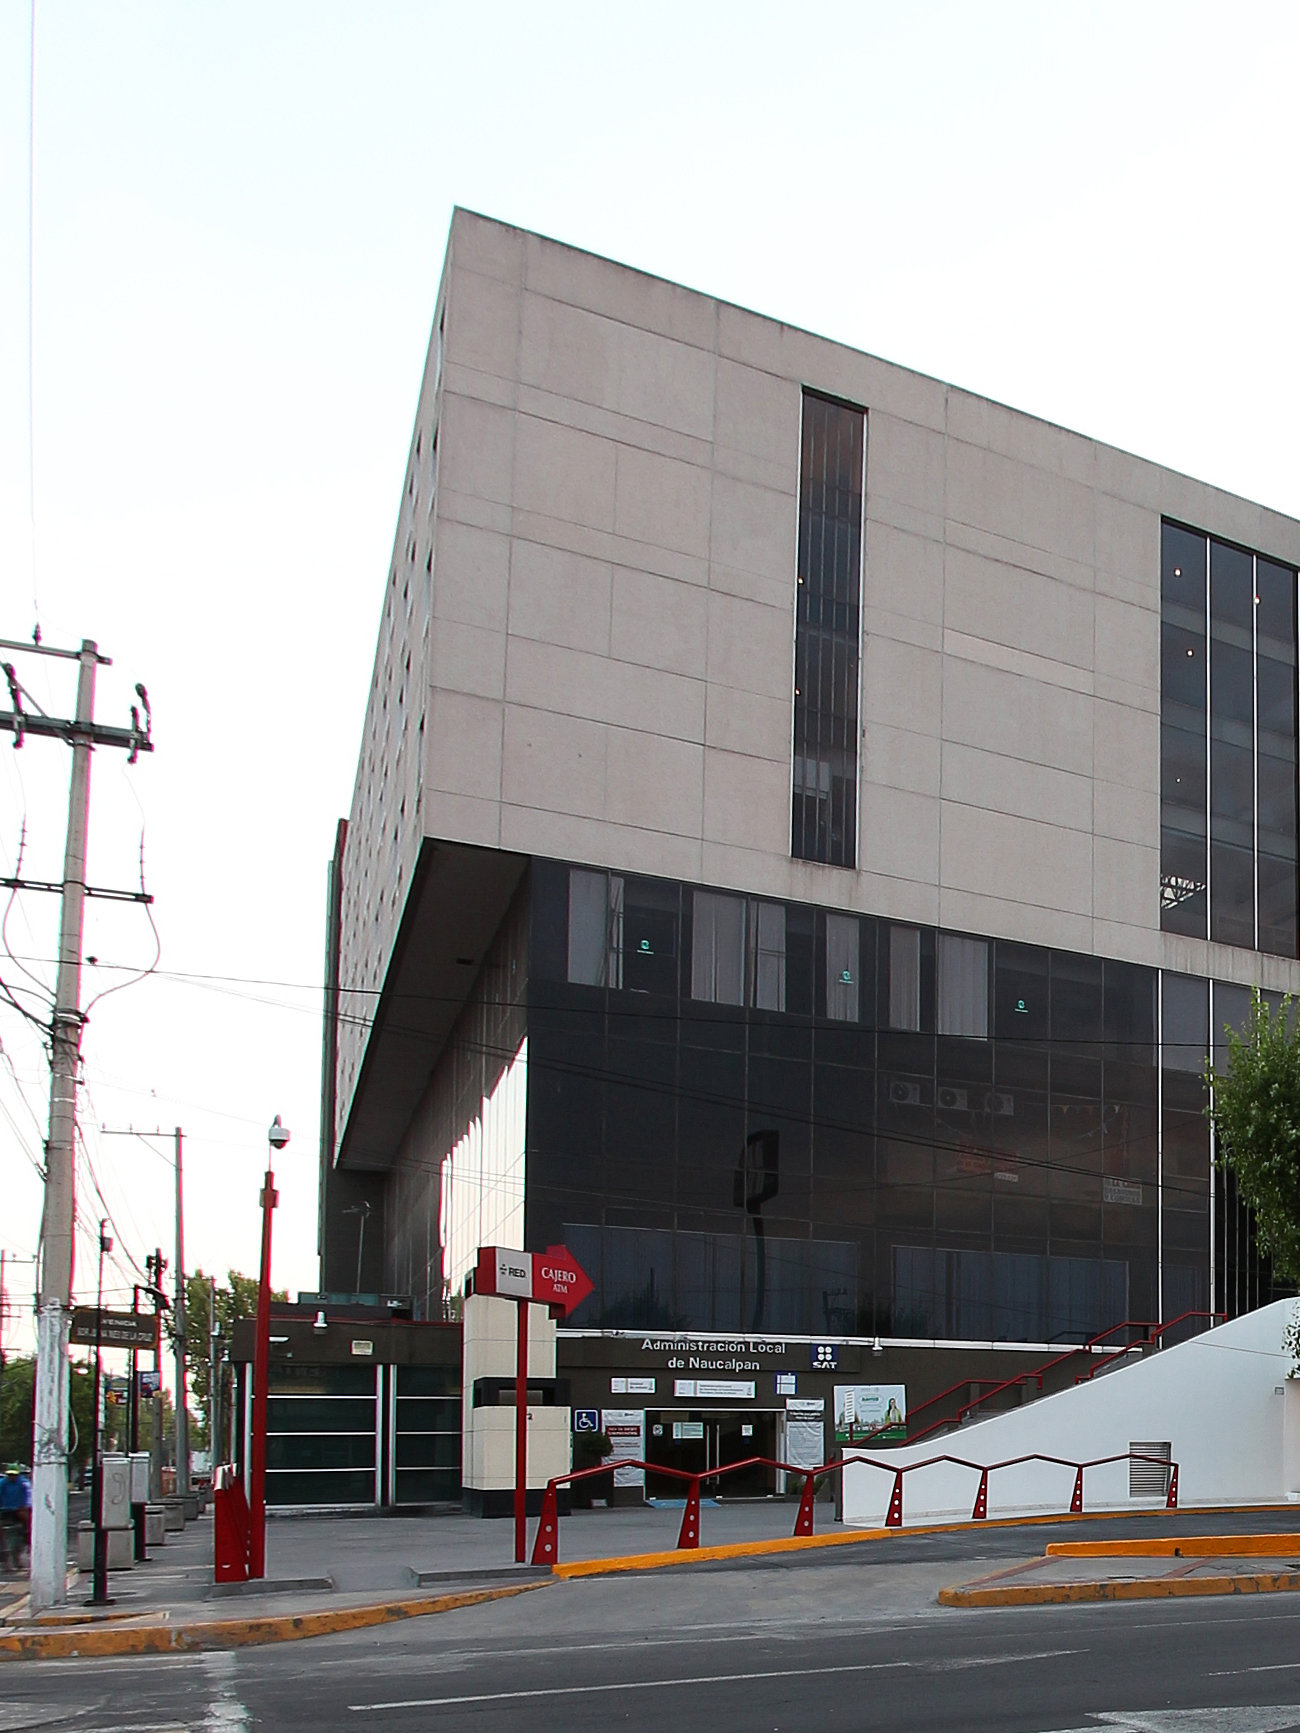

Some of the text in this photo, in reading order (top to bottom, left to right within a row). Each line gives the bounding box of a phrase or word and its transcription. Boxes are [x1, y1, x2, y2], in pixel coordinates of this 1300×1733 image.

[508, 1266, 577, 1284] RED CAJERO
[553, 1283, 568, 1294] ATM
[641, 1338, 786, 1354] Administración Local
[667, 1357, 760, 1372] de Naucalpan
[812, 1361, 837, 1369] SAT
